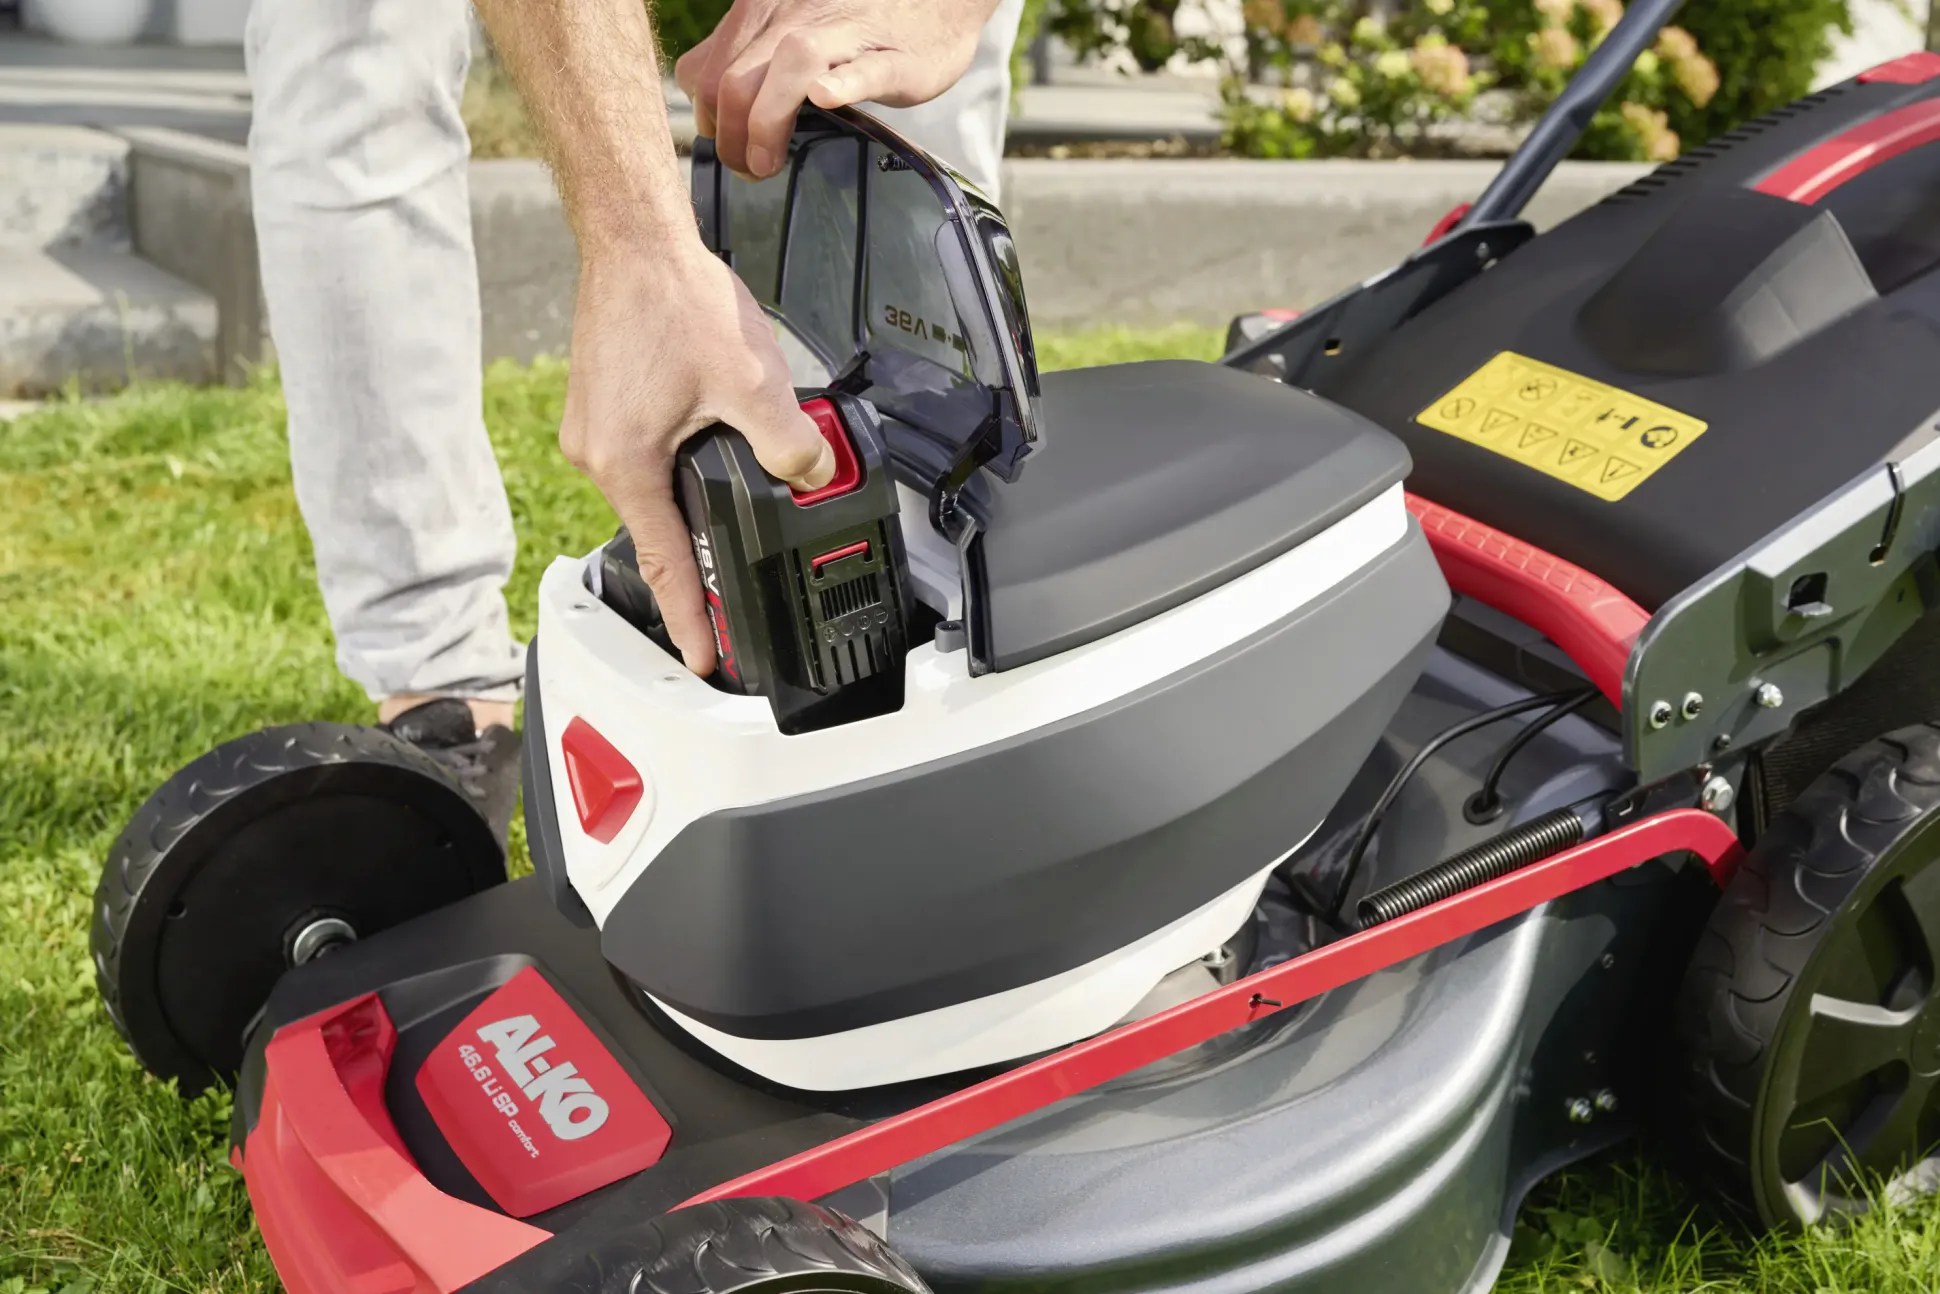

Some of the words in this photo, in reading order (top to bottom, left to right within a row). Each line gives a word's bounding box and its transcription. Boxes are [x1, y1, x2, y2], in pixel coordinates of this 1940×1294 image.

[458, 1044, 493, 1082] 46.6
[476, 1014, 610, 1141] AL-KO
[481, 1077, 504, 1098] Li
[492, 1092, 519, 1118] SP
[508, 1119, 540, 1159] comfort
